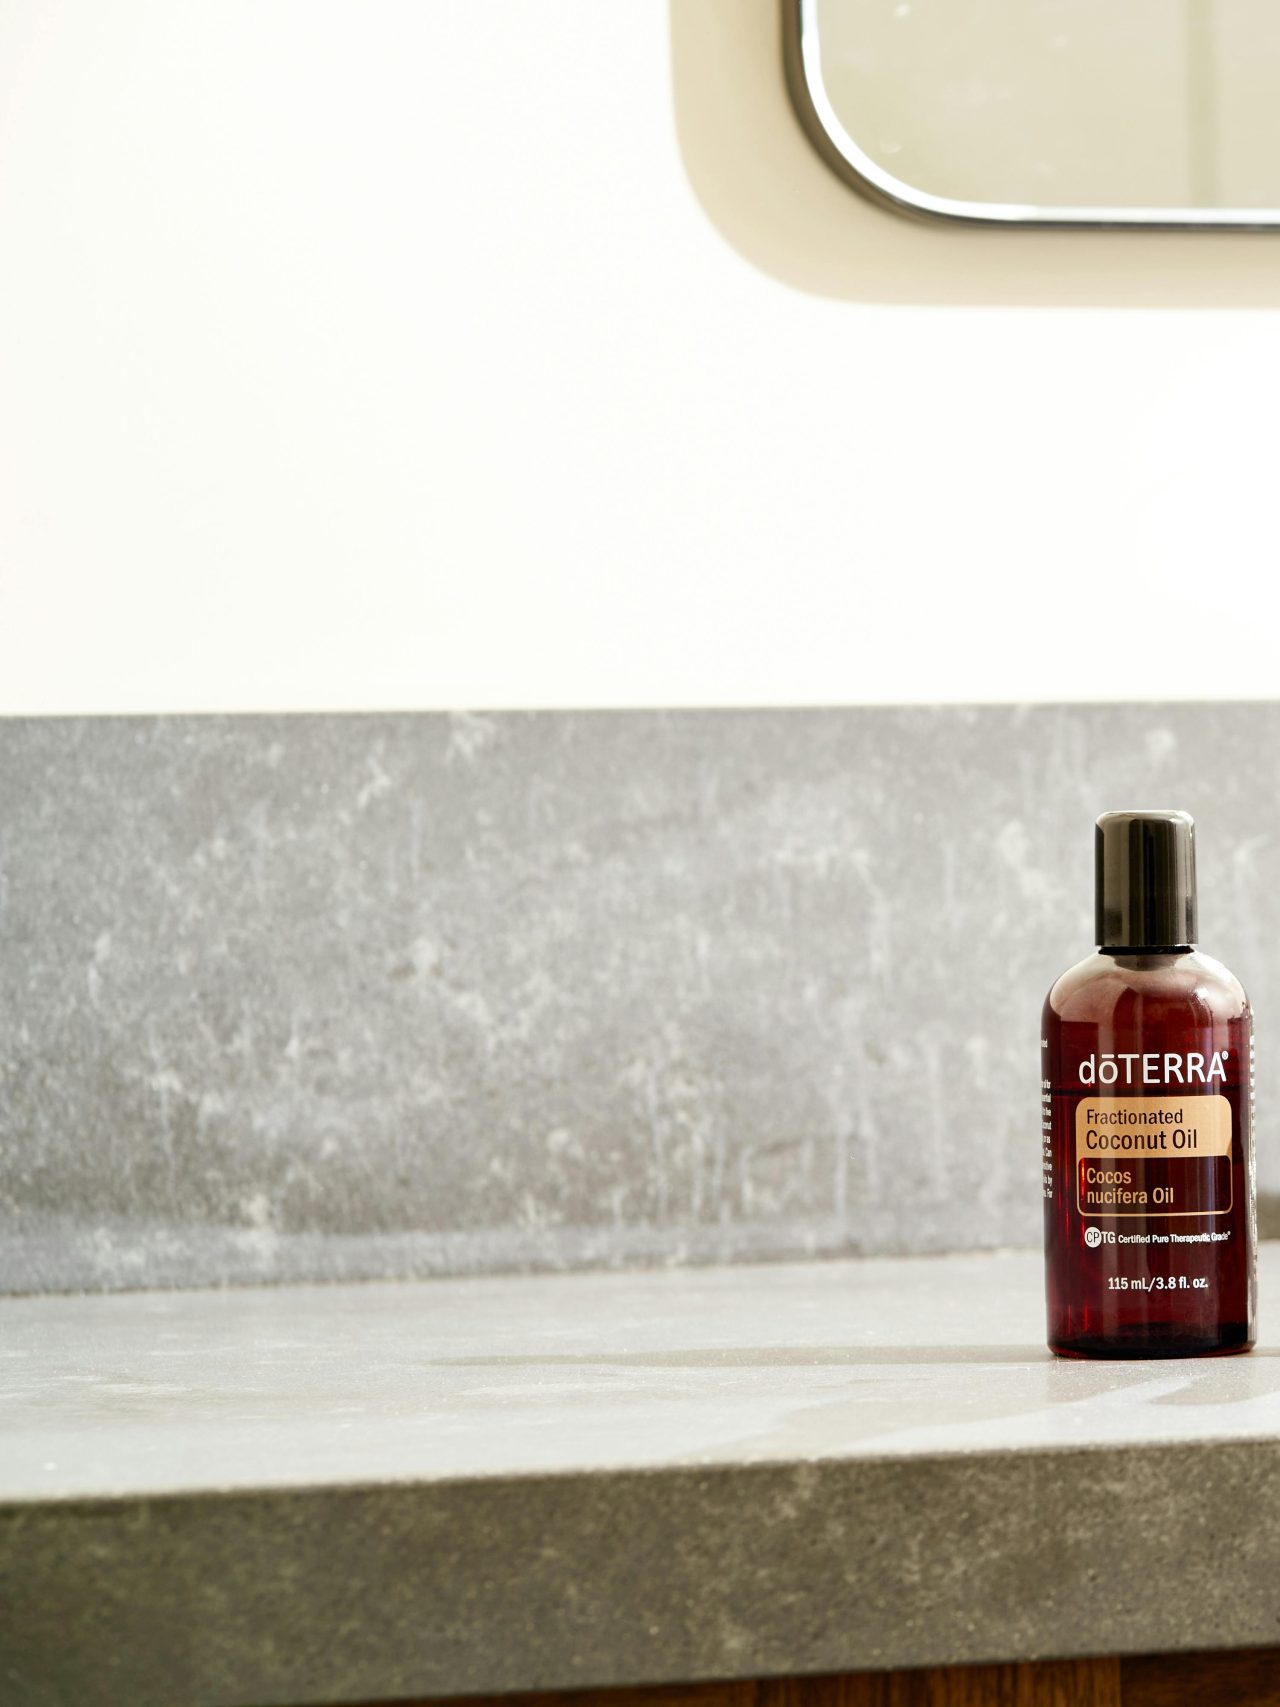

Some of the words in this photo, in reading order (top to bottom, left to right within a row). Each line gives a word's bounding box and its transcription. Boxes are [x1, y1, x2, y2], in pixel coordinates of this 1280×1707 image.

[1086, 1109, 1183, 1125] Fractionated
[1086, 1129, 1167, 1150] Coconut
[1172, 1129, 1197, 1149] Oil
[1086, 1167, 1132, 1184] Cocos
[1086, 1187, 1148, 1204] nucifera
[1152, 1187, 1174, 1204] Oil
[1118, 1234, 1150, 1244] Certified
[1152, 1234, 1169, 1243] Pure
[1170, 1232, 1210, 1244] Therapeutic
[1108, 1277, 1128, 1290] 115
[1179, 1276, 1190, 1289] fl.
[1192, 1277, 1208, 1289] oz.
